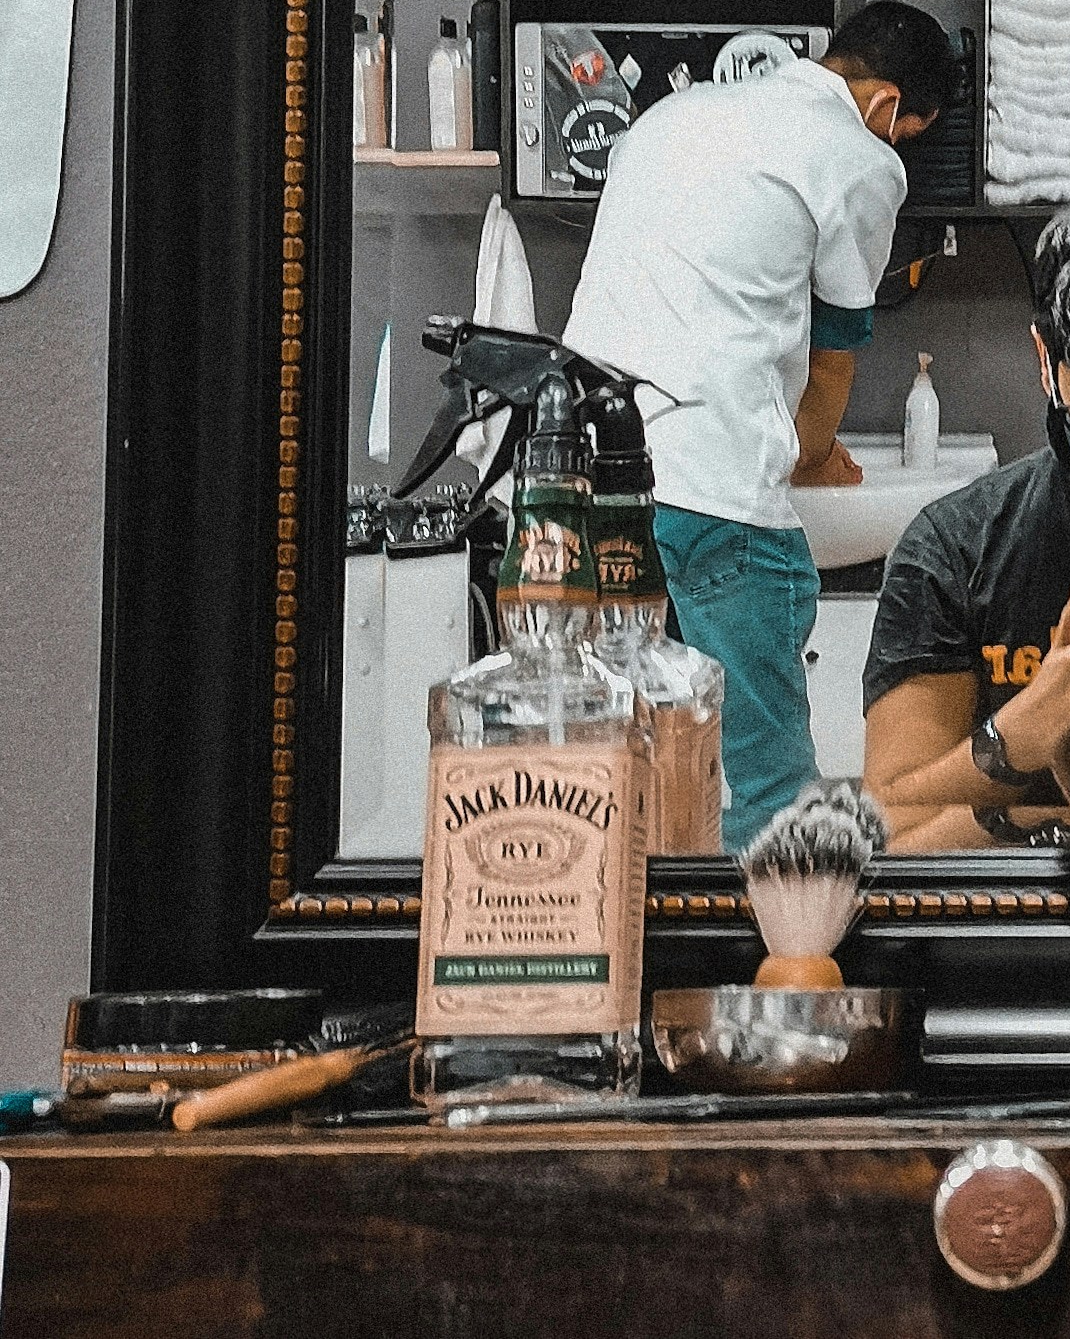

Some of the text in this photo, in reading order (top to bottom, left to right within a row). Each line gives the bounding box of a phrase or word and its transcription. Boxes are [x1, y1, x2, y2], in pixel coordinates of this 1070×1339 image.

[443, 770, 619, 832] JACK DANIEL'S
[500, 841, 545, 859] RYE
